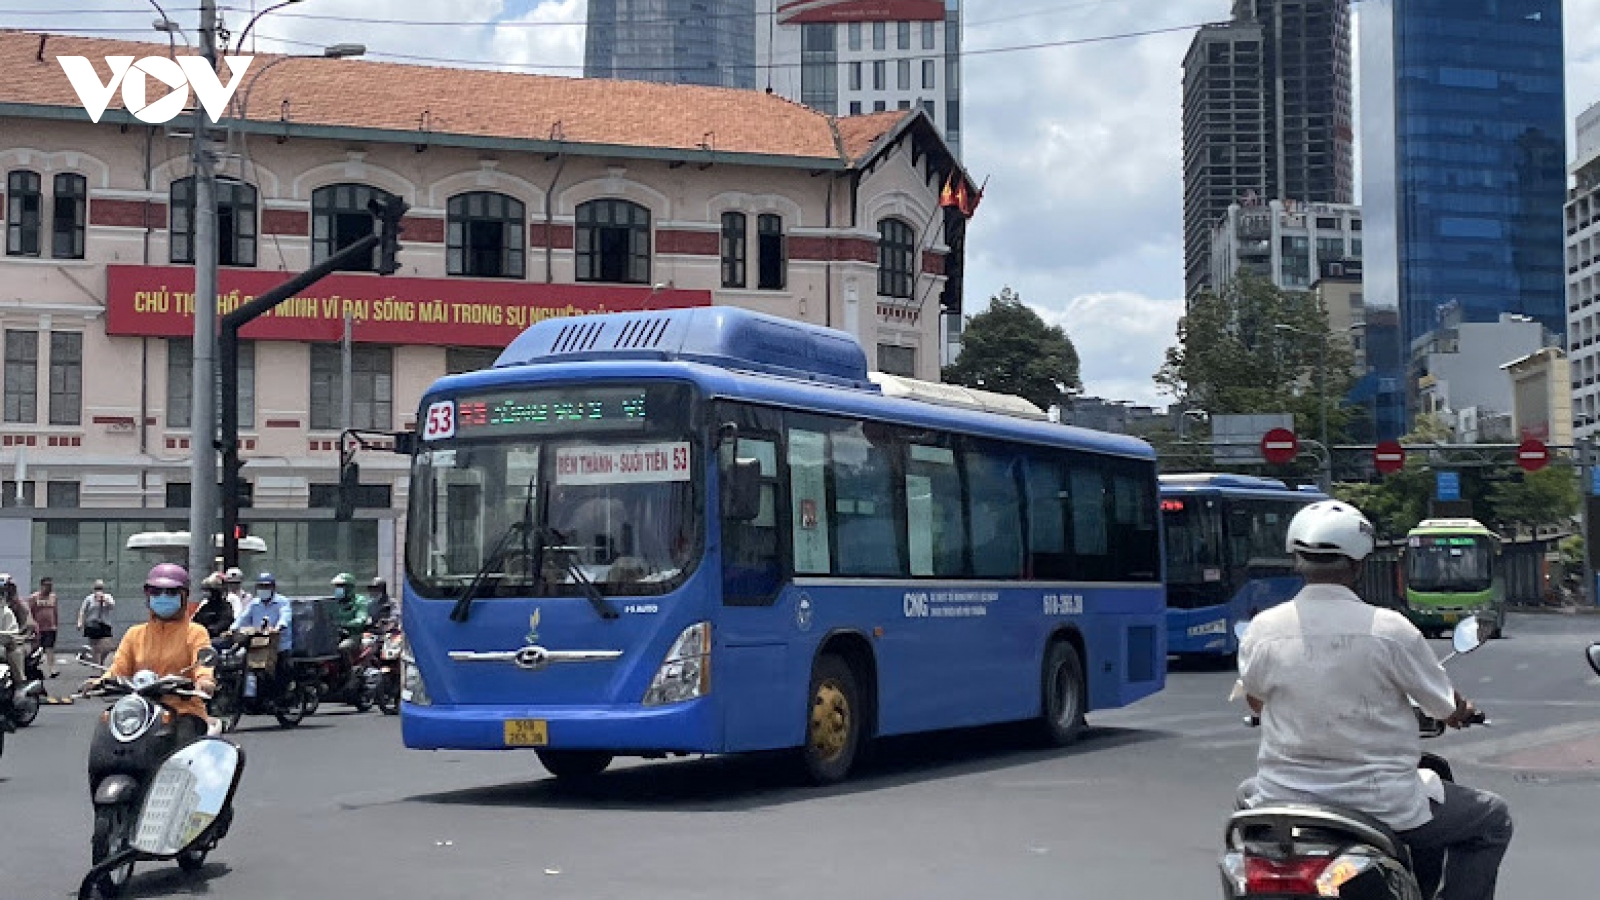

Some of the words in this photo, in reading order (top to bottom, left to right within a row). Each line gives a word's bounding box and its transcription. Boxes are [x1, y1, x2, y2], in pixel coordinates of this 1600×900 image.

[135, 285, 169, 313] CHỦ
[173, 293, 196, 317] TỊC
[275, 298, 317, 317] MINH
[322, 295, 341, 319] VĨ
[373, 295, 415, 321] SỐNG
[418, 299, 449, 323] MÃI
[451, 303, 502, 325] TRONG
[428, 406, 451, 434] 53
[579, 452, 613, 474] THÀNH
[673, 447, 687, 471] 53
[903, 592, 928, 617] CNG
